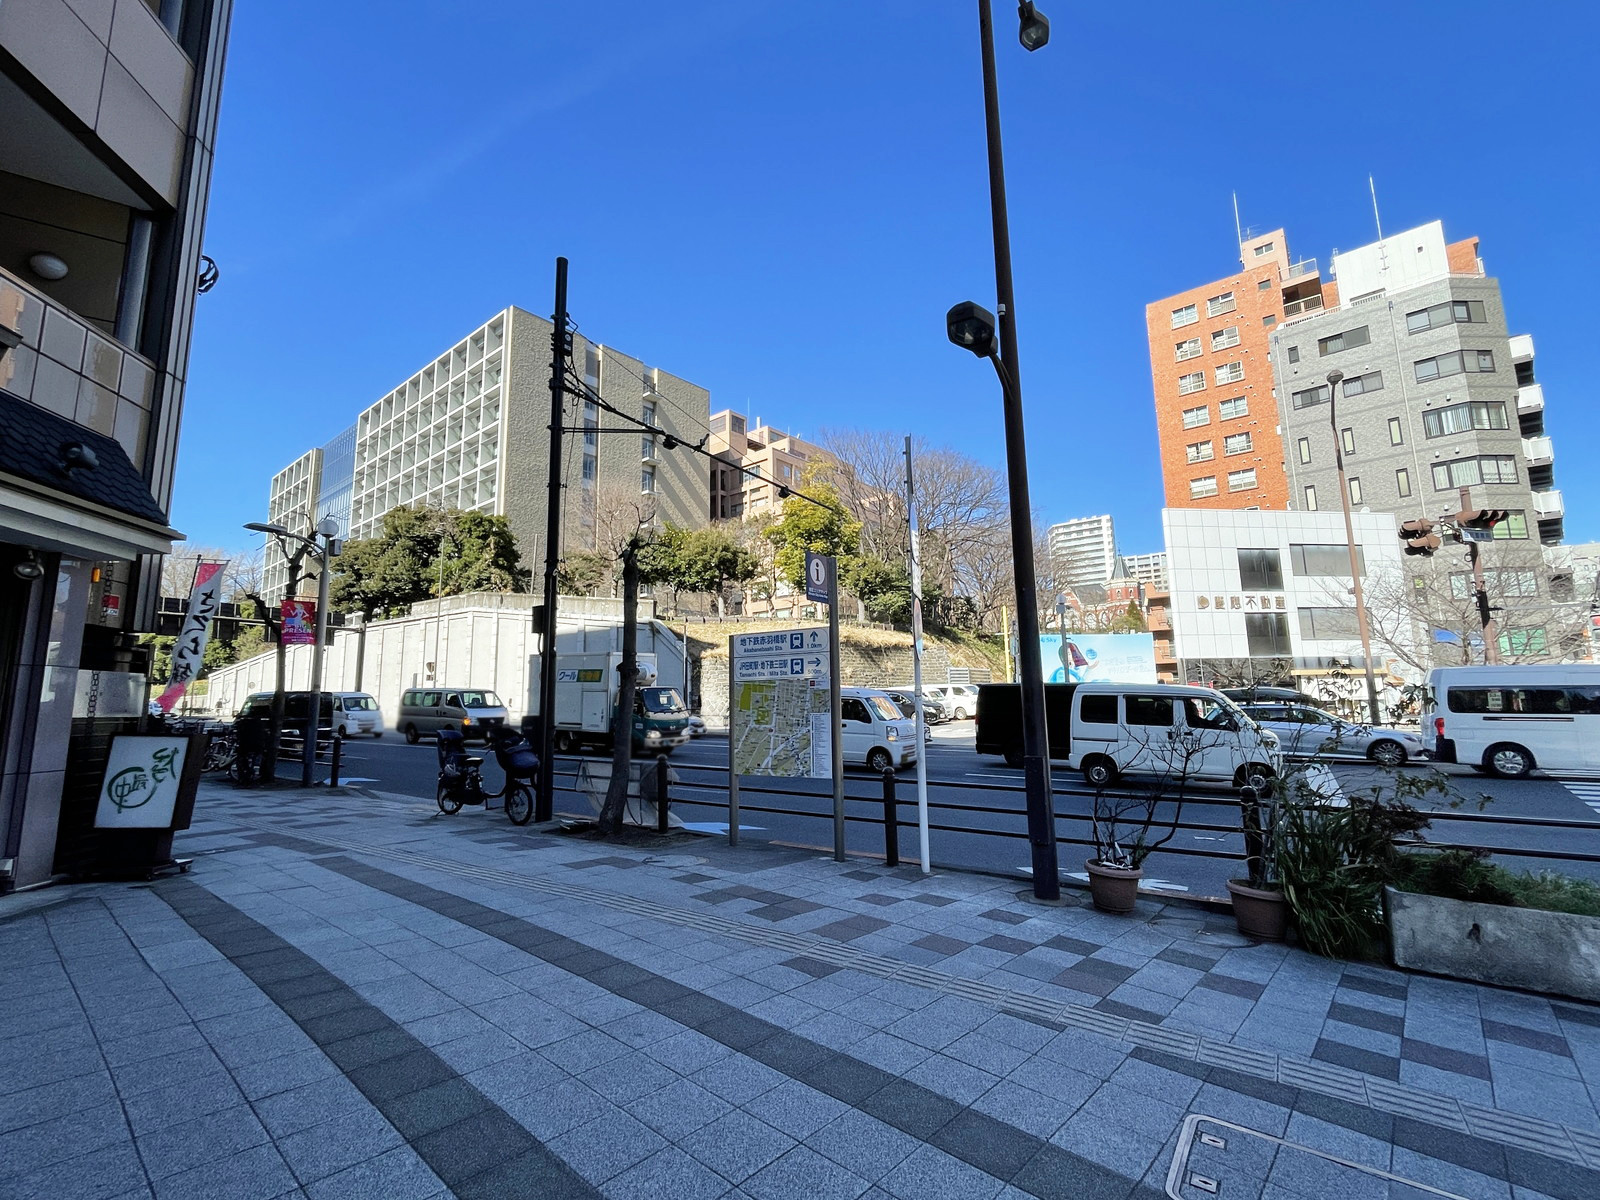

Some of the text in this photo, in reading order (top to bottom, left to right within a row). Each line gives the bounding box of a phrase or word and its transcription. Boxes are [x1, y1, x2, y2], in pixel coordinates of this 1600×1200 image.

[740, 634, 787, 646] 地下鉄赤羽橋駅
[558, 671, 577, 680] クール
